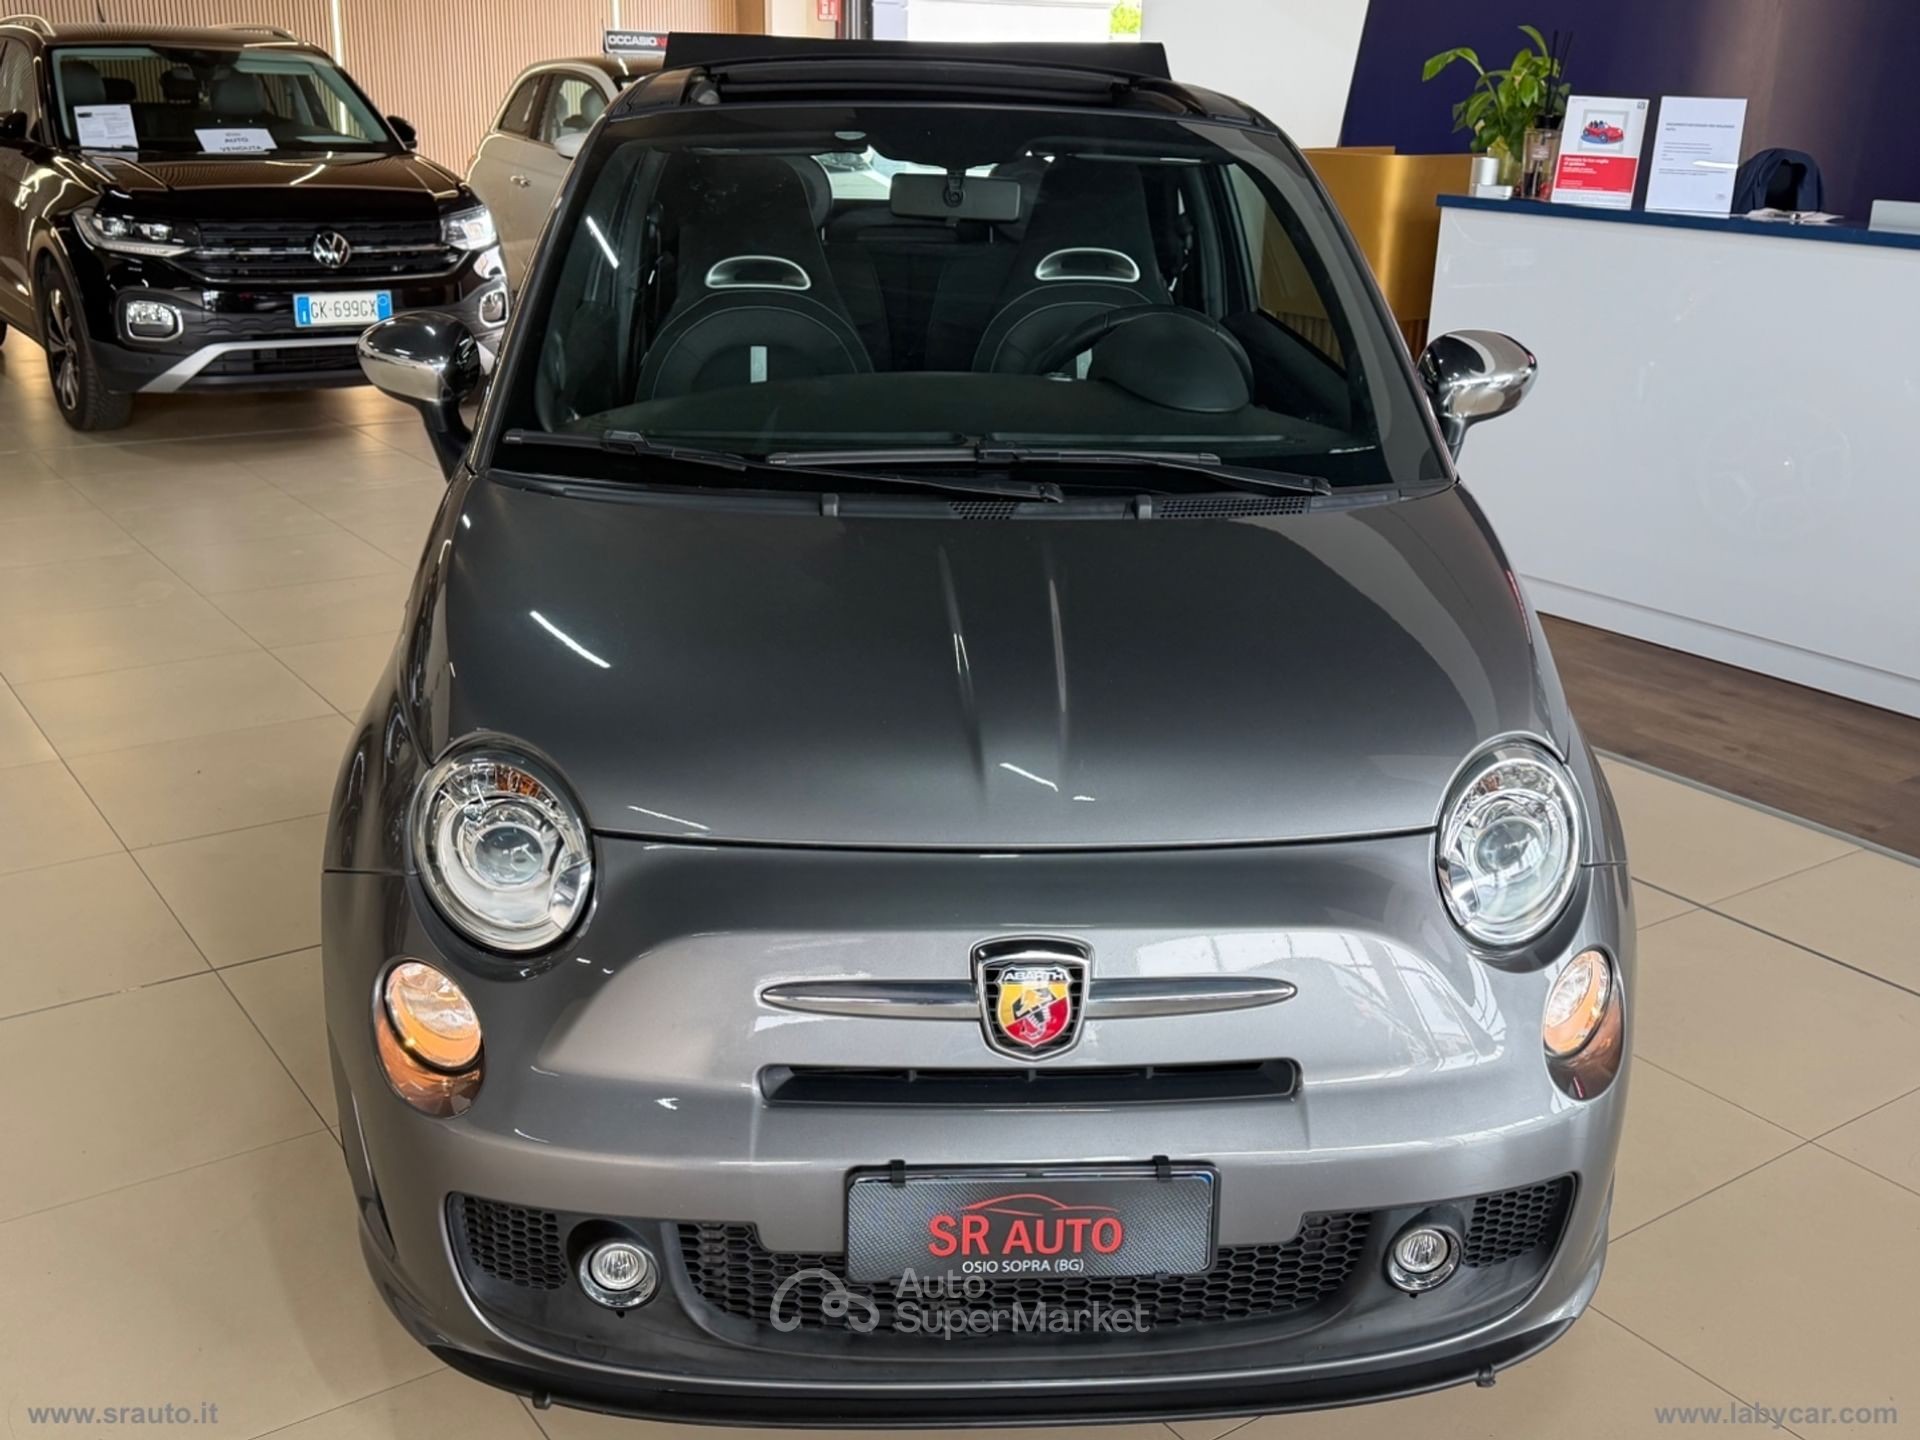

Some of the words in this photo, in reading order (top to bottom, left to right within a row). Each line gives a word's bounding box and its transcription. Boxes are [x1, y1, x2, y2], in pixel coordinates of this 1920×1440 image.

[1003, 970, 1064, 982] ABARTH
[928, 1214, 990, 1257] SR
[1002, 1216, 1124, 1255] AUTO
[962, 1260, 999, 1274] OSIO
[1002, 1259, 1051, 1273] SOPRA
[1054, 1258, 1085, 1273] (BG)
